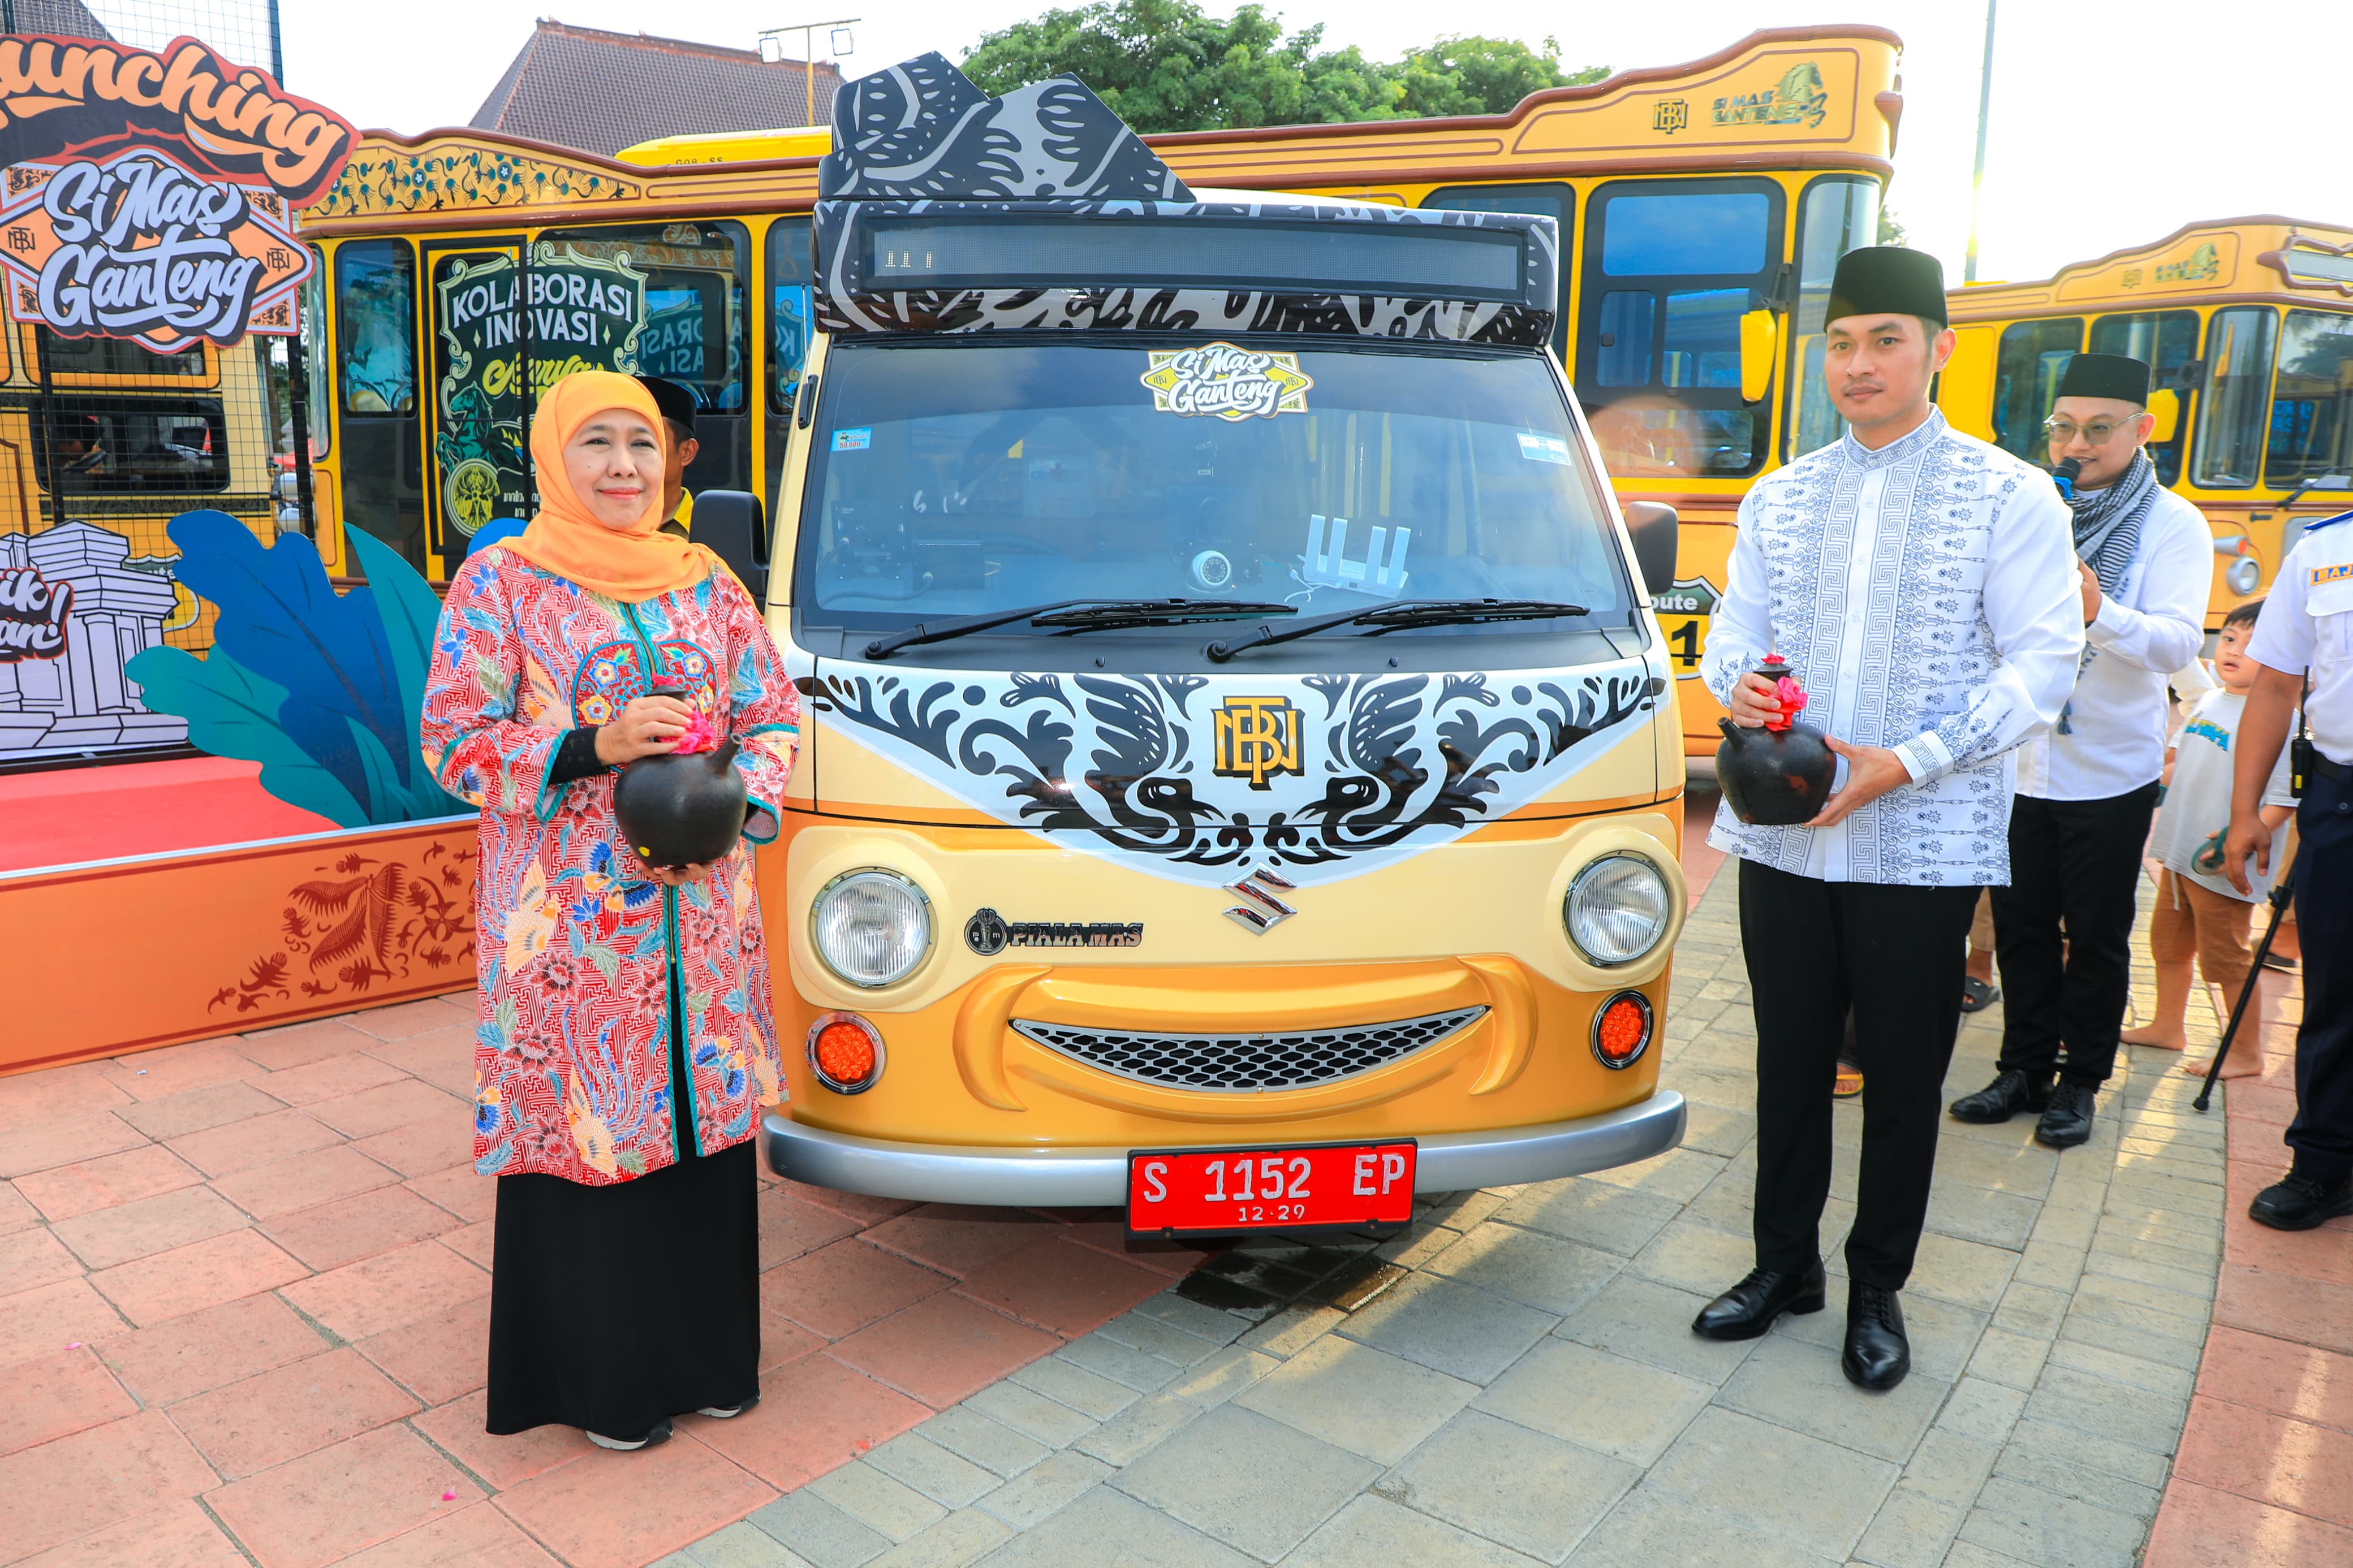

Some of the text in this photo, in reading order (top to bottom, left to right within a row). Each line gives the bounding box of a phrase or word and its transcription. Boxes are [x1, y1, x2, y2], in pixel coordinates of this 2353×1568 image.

[0, 40, 346, 187] unching
[1730, 90, 1774, 109] MAS
[44, 162, 243, 247] Si Mas
[40, 224, 260, 338] Ganteng
[453, 273, 632, 329] KOLABORASI
[486, 309, 597, 349] INOVASI
[1170, 348, 1271, 380] Si Mas
[1168, 370, 1282, 414] Ganteng
[1650, 594, 1699, 611] oute
[1671, 620, 1699, 667] 1
[1010, 922, 1144, 947] PIALA MAS
[1143, 1154, 1406, 1202] S 1152 EP
